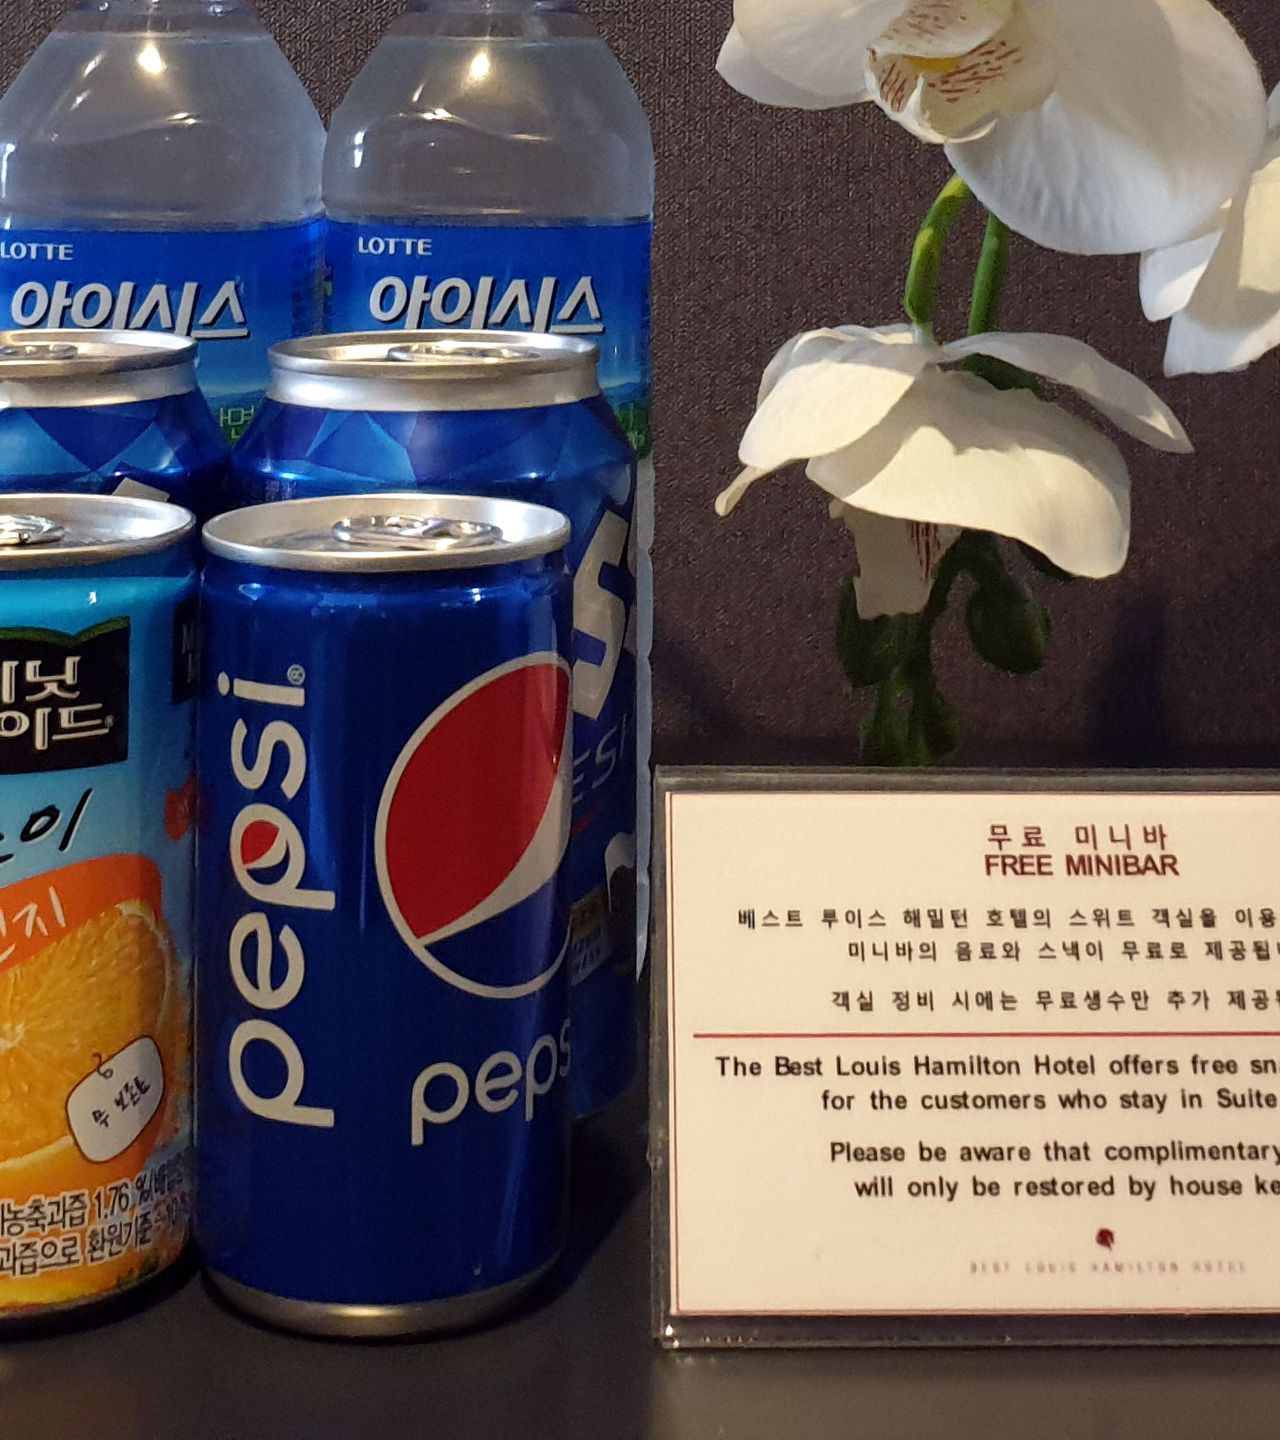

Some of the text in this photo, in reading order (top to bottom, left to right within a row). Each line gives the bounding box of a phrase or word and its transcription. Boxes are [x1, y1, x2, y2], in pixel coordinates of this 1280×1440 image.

[0, 241, 74, 261] LOTTE
[357, 236, 433, 256] LOTTE
[10, 280, 249, 338] 아이시스
[369, 275, 604, 334] 아이시스
[987, 823, 1169, 852] 무료 미니바
[984, 852, 1181, 878] FREE MINIBAR
[218, 671, 336, 1129] pepsi
[737, 908, 804, 931] 베스트
[820, 908, 887, 930] 루이스
[902, 907, 969, 930] 해밀턴
[985, 907, 1052, 930] 호텔의
[1068, 907, 1136, 930] 스위트
[1151, 907, 1218, 930] 객실을
[847, 940, 937, 963] 미니바의
[954, 940, 1021, 963] 음료와
[1037, 939, 1104, 963] 스낵이
[1120, 940, 1189, 963] 무료로
[831, 989, 874, 1013] 객실
[891, 989, 935, 1013] 정비
[951, 989, 1019, 1013] 시에는
[1034, 989, 1150, 1013] 무료생수만
[1166, 988, 1211, 1012] 추가
[714, 1055, 762, 1078] The
[774, 1055, 824, 1077] Best
[835, 1054, 902, 1077] Louis
[913, 1053, 1021, 1077] Hamilton
[1033, 1053, 1096, 1077] Hotel
[1108, 1053, 1180, 1077] offers
[1189, 1052, 1239, 1076] free
[410, 1014, 571, 1147] peps
[820, 1088, 856, 1111] for
[869, 1088, 908, 1111] the
[920, 1089, 1047, 1112] customers
[1056, 1087, 1108, 1111] who
[1118, 1089, 1169, 1115] stay
[1179, 1087, 1204, 1110] in
[1215, 1086, 1279, 1111] Suite
[829, 1140, 906, 1164] Please
[918, 1139, 948, 1163] be
[959, 1145, 1032, 1163] aware
[1042, 1139, 1092, 1163] that
[93, 1181, 131, 1220] 1.76
[853, 1175, 894, 1199] will
[906, 1174, 960, 1203] only
[971, 1174, 1001, 1198] be
[1013, 1173, 1116, 1198] restored
[1127, 1173, 1158, 1203] by
[1168, 1173, 1244, 1197] house
